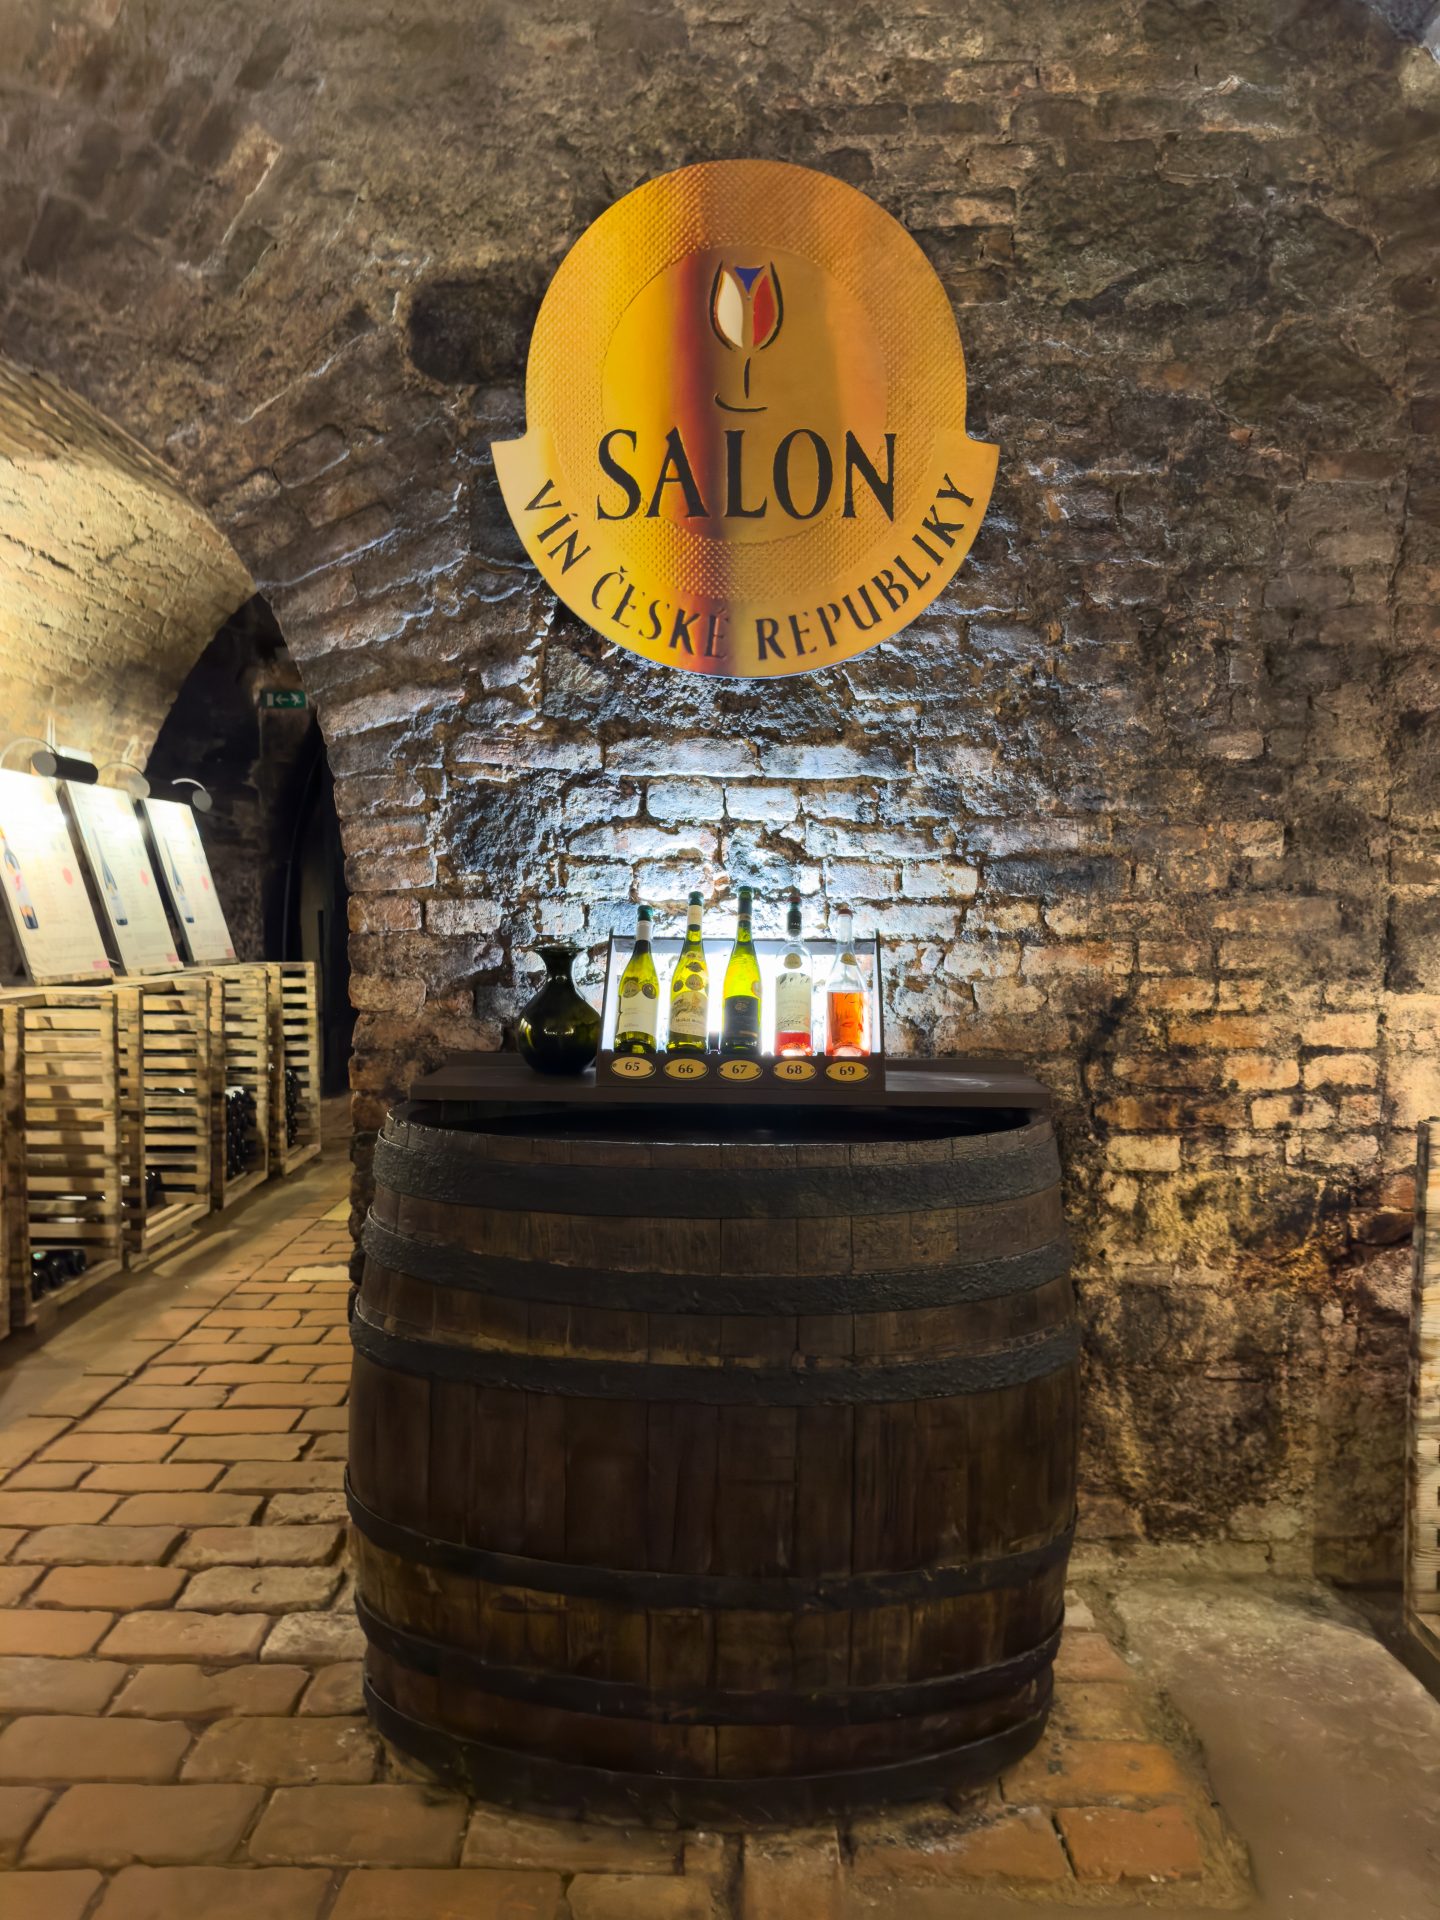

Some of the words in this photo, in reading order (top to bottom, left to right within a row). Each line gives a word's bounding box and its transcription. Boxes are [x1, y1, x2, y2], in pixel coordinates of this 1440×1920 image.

[597, 428, 897, 523] SALON
[524, 478, 592, 576] VÍN
[591, 565, 730, 659] ČESKÉ
[755, 472, 975, 661] REPUBLIKY
[624, 1061, 641, 1072] 65
[678, 1063, 694, 1075] 66
[731, 1064, 747, 1075] 67
[786, 1064, 803, 1075] 68
[839, 1065, 856, 1076] 69
